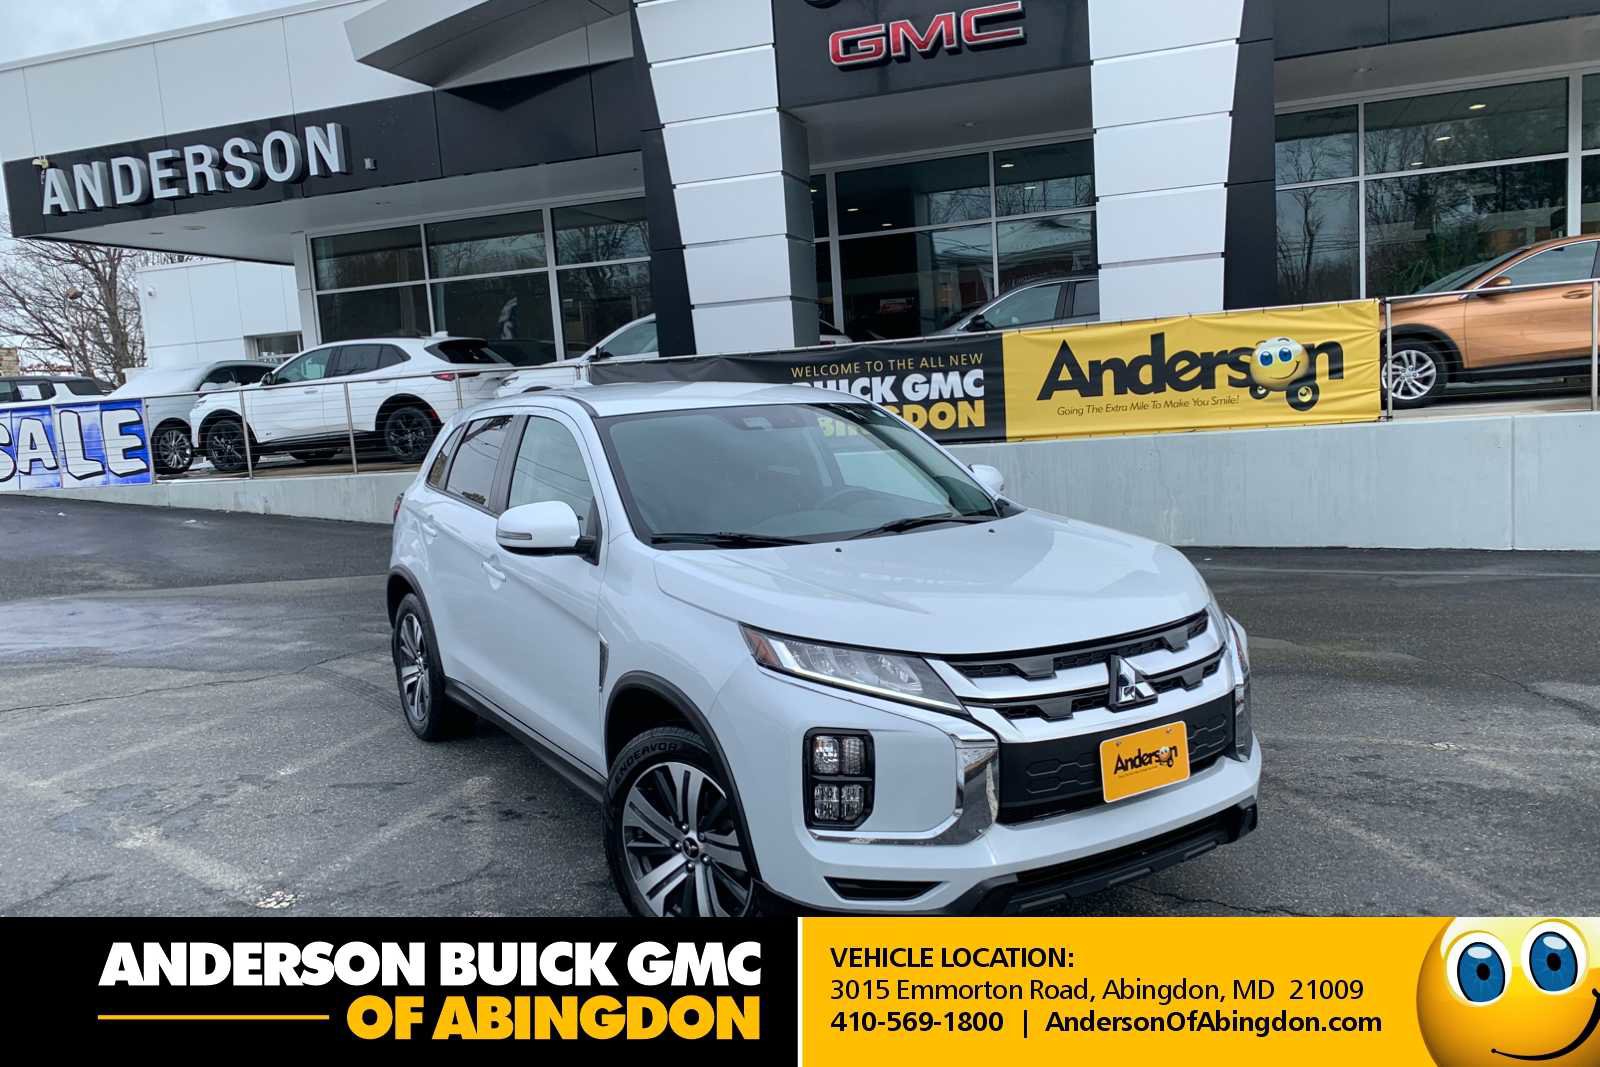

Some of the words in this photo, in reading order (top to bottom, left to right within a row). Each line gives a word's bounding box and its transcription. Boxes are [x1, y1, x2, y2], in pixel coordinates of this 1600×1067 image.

[829, 0, 1025, 67] GMC
[42, 122, 346, 215] ANDERSON
[791, 362, 861, 378] WELCOME
[865, 360, 884, 372] TO
[888, 357, 915, 371] THE
[919, 355, 945, 369] ALL
[949, 352, 984, 366] NEW
[791, 375, 900, 403] ICK
[902, 369, 985, 402] GMC
[1056, 406, 1084, 417] Going
[1086, 404, 1104, 414] The
[1105, 402, 1128, 413] Extra
[1129, 401, 1149, 411] Mile
[1151, 400, 1162, 409] To
[1163, 399, 1189, 409] Make
[1192, 398, 1209, 407] You
[1211, 395, 1240, 406] Smile!
